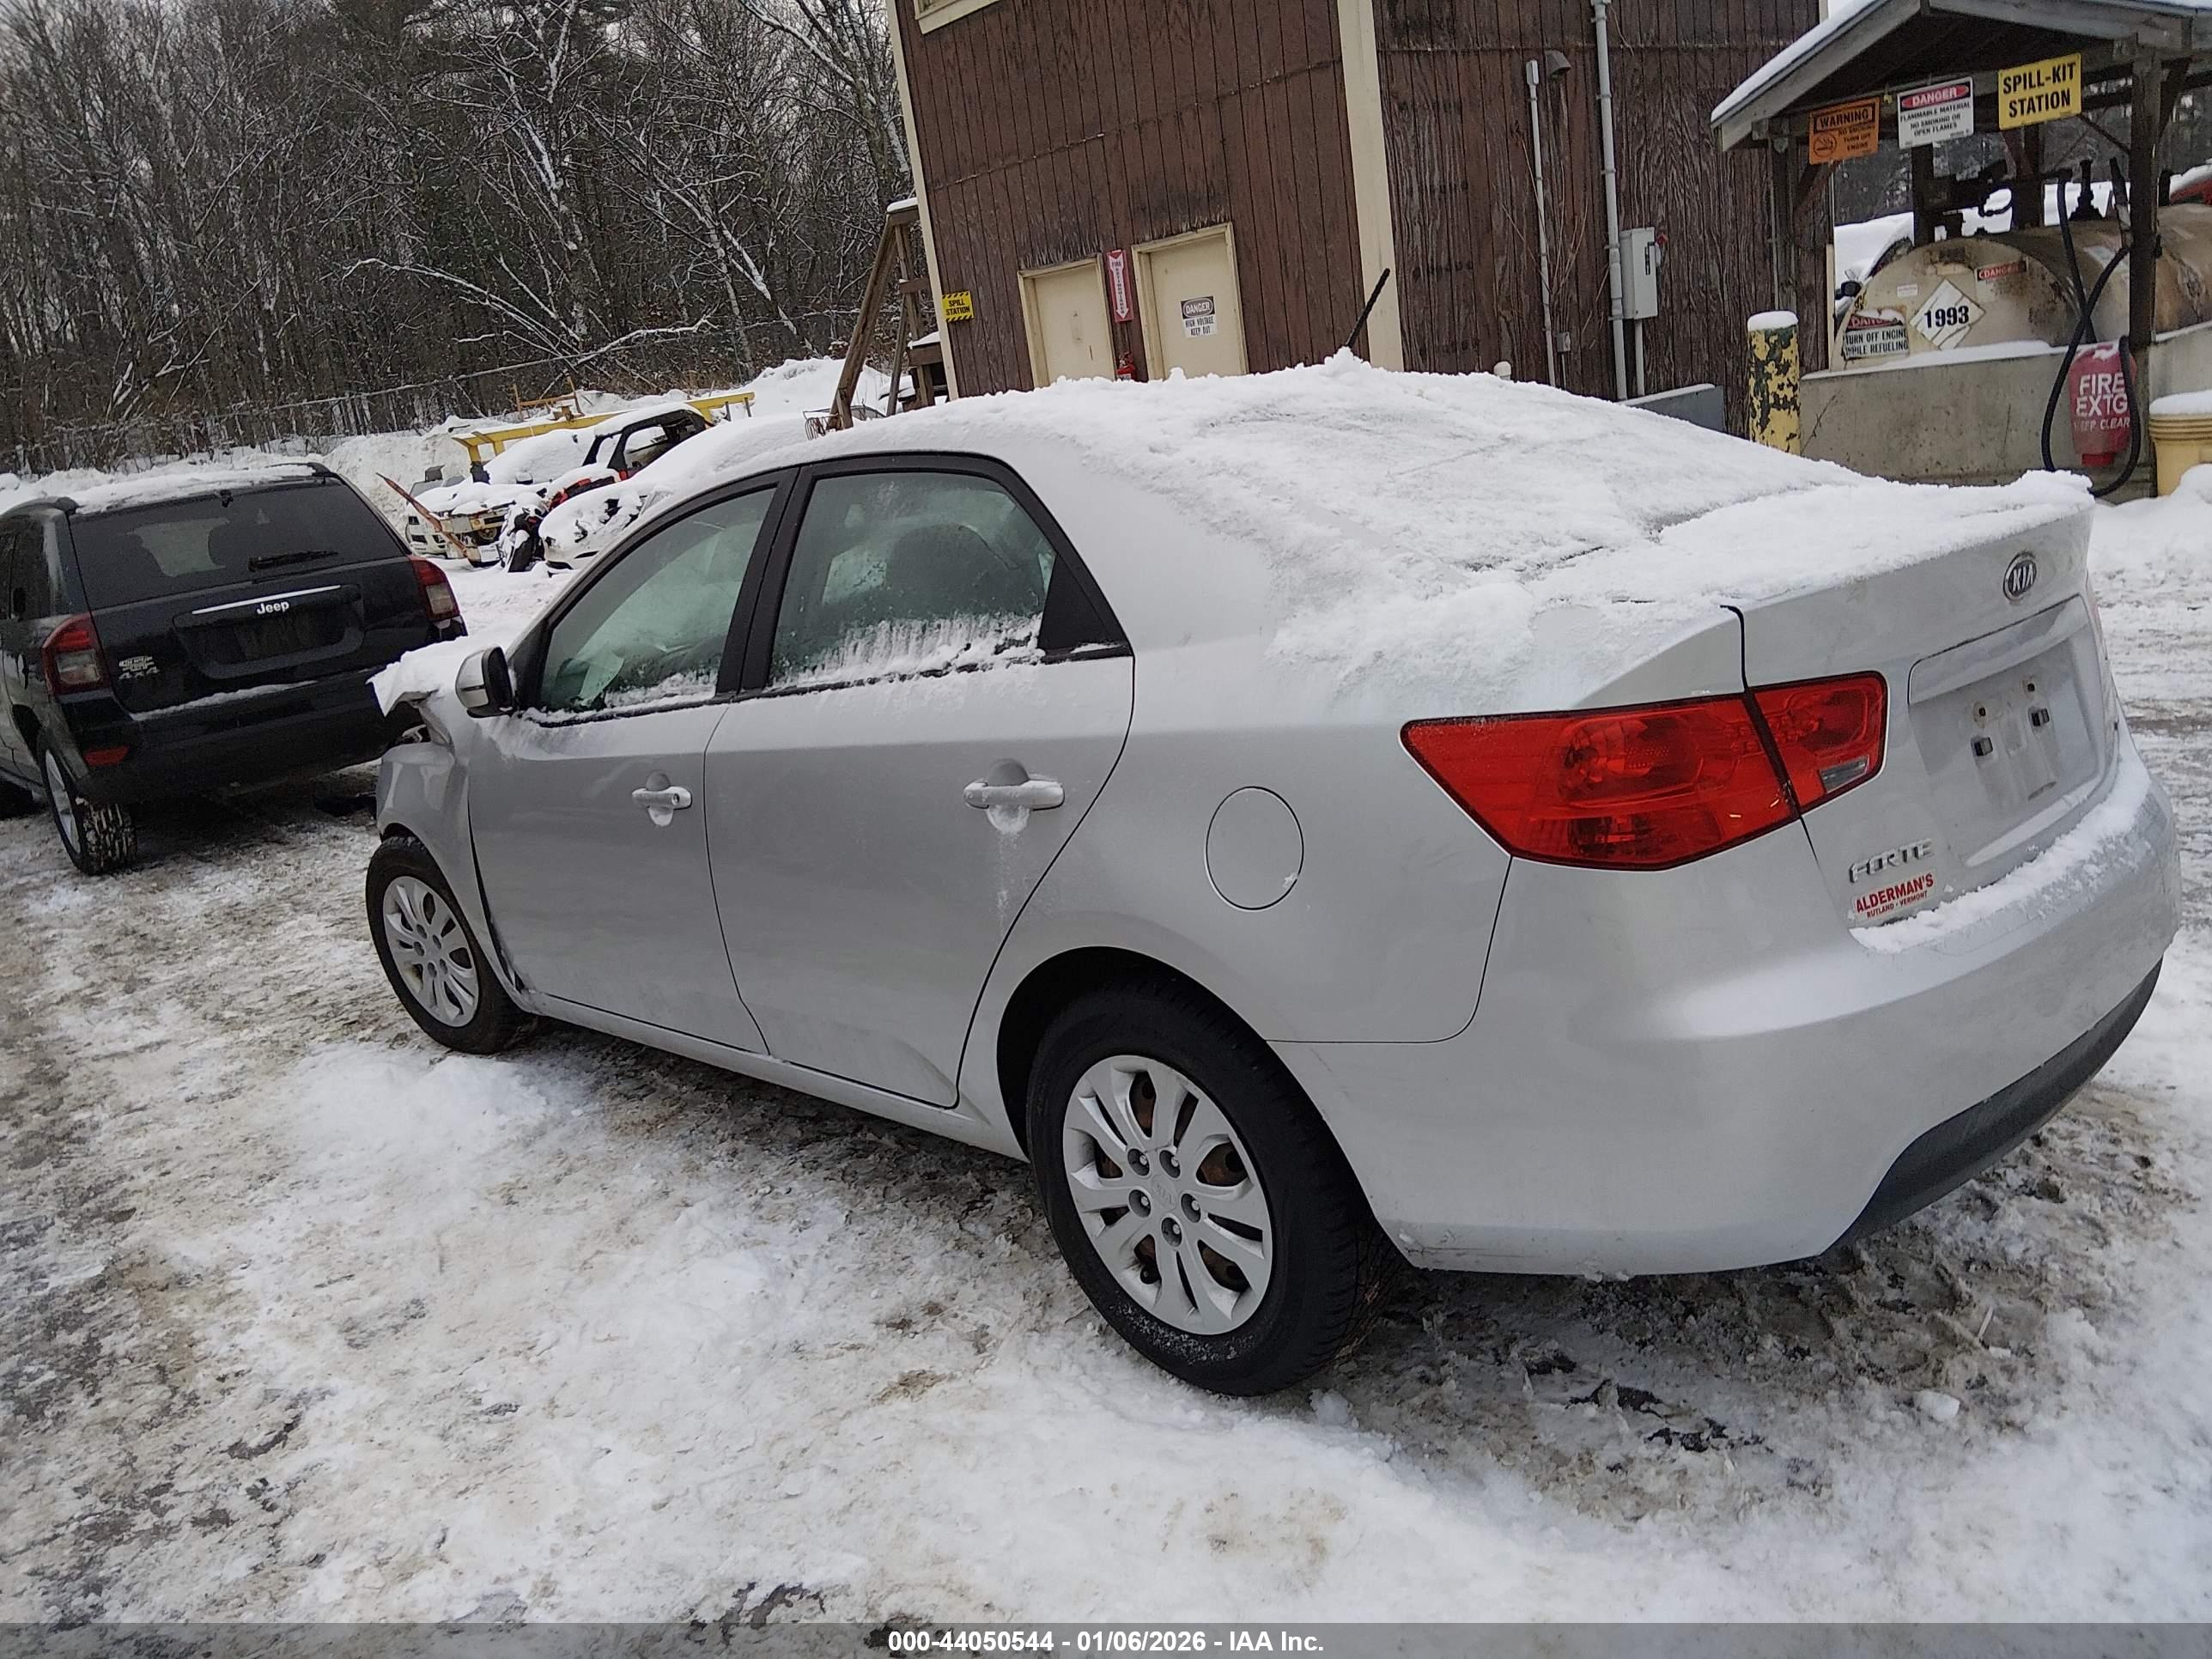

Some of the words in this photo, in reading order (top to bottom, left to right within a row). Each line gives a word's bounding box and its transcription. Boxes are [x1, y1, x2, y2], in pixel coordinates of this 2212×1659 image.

[2002, 62, 2075, 94] SPILL-KIT
[1912, 88, 1957, 106] DANGER
[2009, 88, 2070, 118] STATION
[1820, 108, 1869, 128] WARNING
[1900, 109, 1937, 123] FLAMMABLE
[1940, 101, 1970, 112] MATERIAL
[1921, 116, 1950, 127] SMOKING
[1932, 122, 1957, 134] FLAMES
[946, 306, 970, 316] STATION
[949, 298, 965, 307] SPILL
[1186, 301, 1211, 314] DANGER
[1197, 315, 1214, 326] VOLTAGE
[1924, 305, 1969, 329] 1993
[1846, 334, 1863, 345] TURN
[1866, 331, 1879, 343] OFF
[1870, 340, 1909, 354] REFUELING
[2079, 372, 2126, 395] FIRE
[2075, 393, 2128, 418] EXTG
[2100, 416, 2130, 429] CLEAR
[2012, 562, 2033, 592] KIA
[257, 601, 289, 615] Jeep
[1849, 836, 1935, 884] FORTE
[1856, 872, 1934, 914] ALDERMAN'S
[1866, 902, 1894, 919] RUTLAND
[1899, 890, 1928, 907] VERMONT
